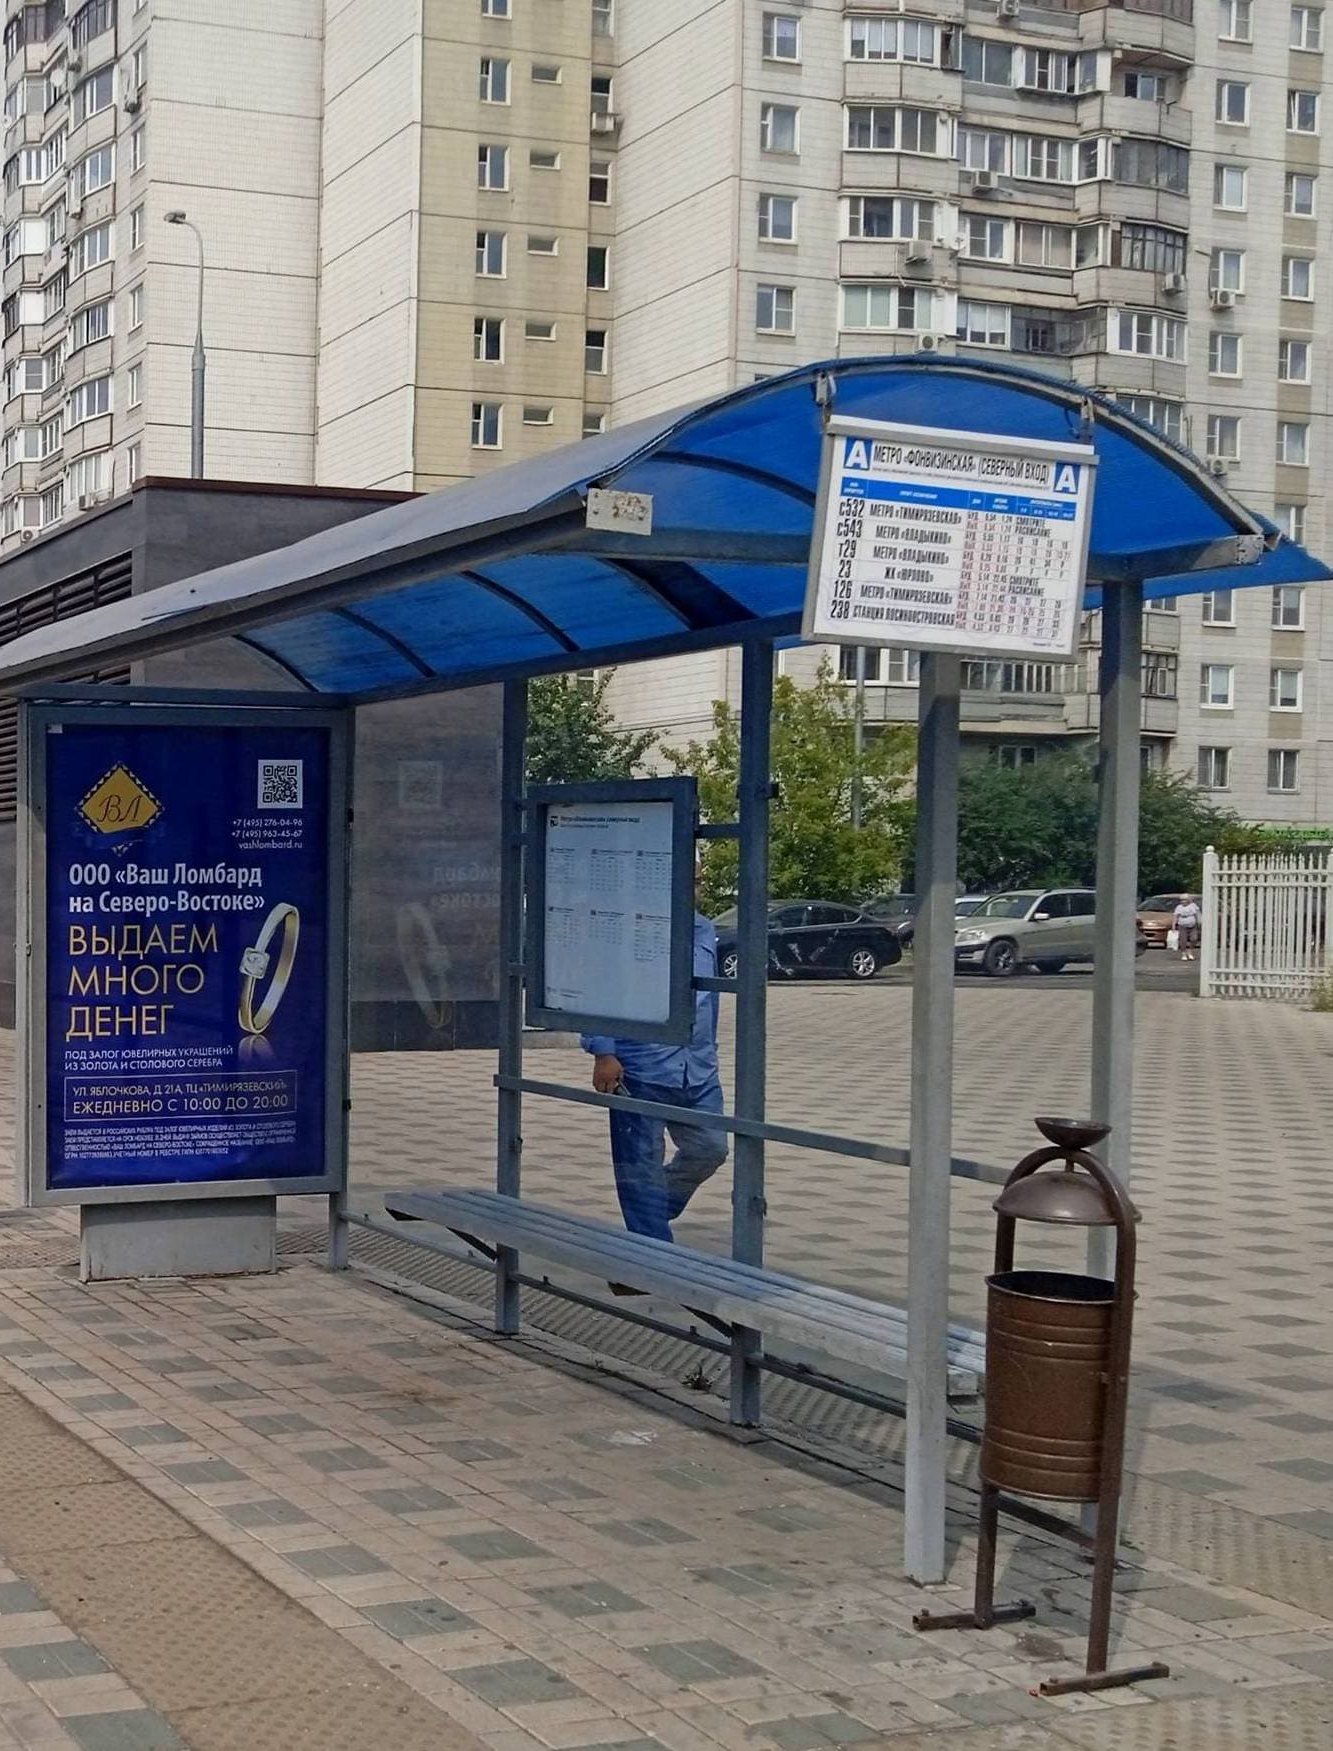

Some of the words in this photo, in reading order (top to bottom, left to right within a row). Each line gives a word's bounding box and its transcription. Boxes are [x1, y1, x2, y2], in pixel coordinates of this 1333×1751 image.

[873, 446, 903, 464] МЕТРО
[977, 456, 1024, 479] (СЕВЕРНЫЙ
[1025, 462, 1049, 485] ВХОД)
[839, 496, 866, 518] с532
[869, 502, 894, 518] МЕТРО
[837, 516, 863, 538] с543
[875, 524, 900, 540] МЕТРО
[838, 538, 857, 558] т29
[873, 545, 897, 560] МЕТРО
[838, 558, 852, 578] 23
[884, 566, 896, 580] ЖК
[833, 579, 852, 599] 126
[860, 584, 885, 599] МЕТРО
[830, 599, 850, 619] 238
[232, 819, 242, 827] +7
[243, 818, 262, 828] (495)
[264, 818, 303, 827] 276-04-96
[232, 830, 241, 838] +7
[242, 830, 261, 839] (495)
[262, 830, 303, 838] 963-45-67
[238, 840, 303, 850] vashlombard.ru
[69, 862, 111, 886] ООО
[115, 862, 170, 886] «Ваш
[172, 862, 262, 890] Ломбард
[69, 896, 93, 913] на
[98, 890, 265, 917] Северо-Востоке»
[68, 923, 219, 961] ВЫДАЕМ
[68, 964, 205, 997] МНОГО
[66, 1004, 175, 1042] ДЕНЕГ
[64, 1050, 87, 1060] ПОД
[89, 1050, 120, 1060] ЗАЛОГ
[121, 1048, 177, 1059] ЮВЕЛИРНЫХ
[178, 1045, 234, 1056] УКРАШЕНИЙ
[64, 1062, 78, 1071] ИЗ
[80, 1061, 119, 1071] ЗОЛОТА
[120, 1062, 128, 1070] И
[129, 1058, 186, 1070] СТОЛОВОГО
[186, 1058, 223, 1068] СЕРЕБРА
[186, 1083, 199, 1094] ТЦ
[73, 1100, 163, 1116] ЕЖЕДНЕВНО
[167, 1099, 178, 1112] С
[183, 1098, 221, 1111] 10:00
[225, 1097, 248, 1112] ДО
[253, 1094, 288, 1109] 20:00
